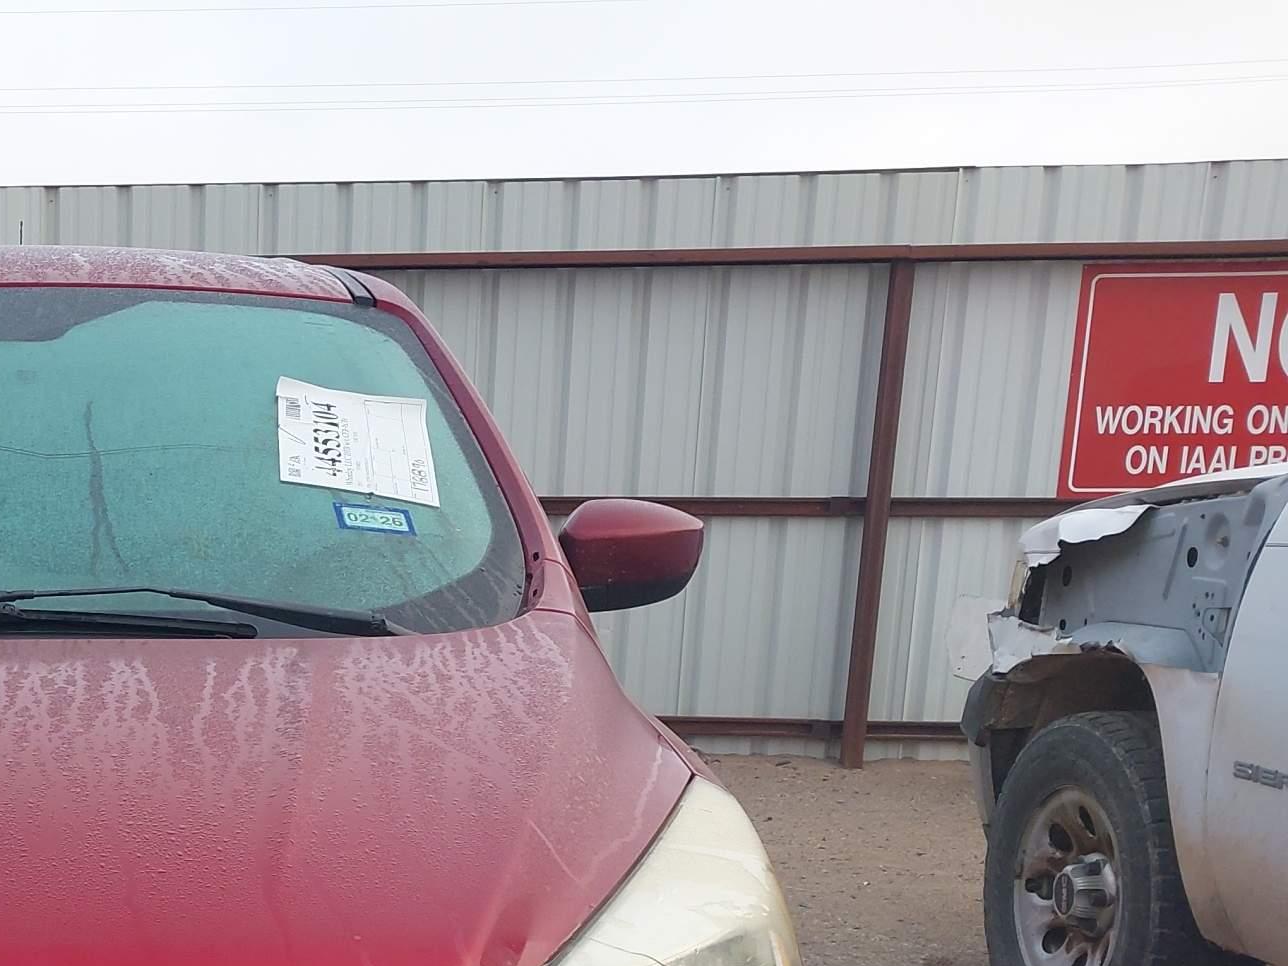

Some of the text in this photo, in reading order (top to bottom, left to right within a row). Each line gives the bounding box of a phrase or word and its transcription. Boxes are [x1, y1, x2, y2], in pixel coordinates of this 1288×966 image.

[1208, 292, 1288, 383] N
[311, 401, 343, 477] 44553104
[1095, 404, 1288, 435] WORKING ON
[1125, 445, 1169, 475] ON
